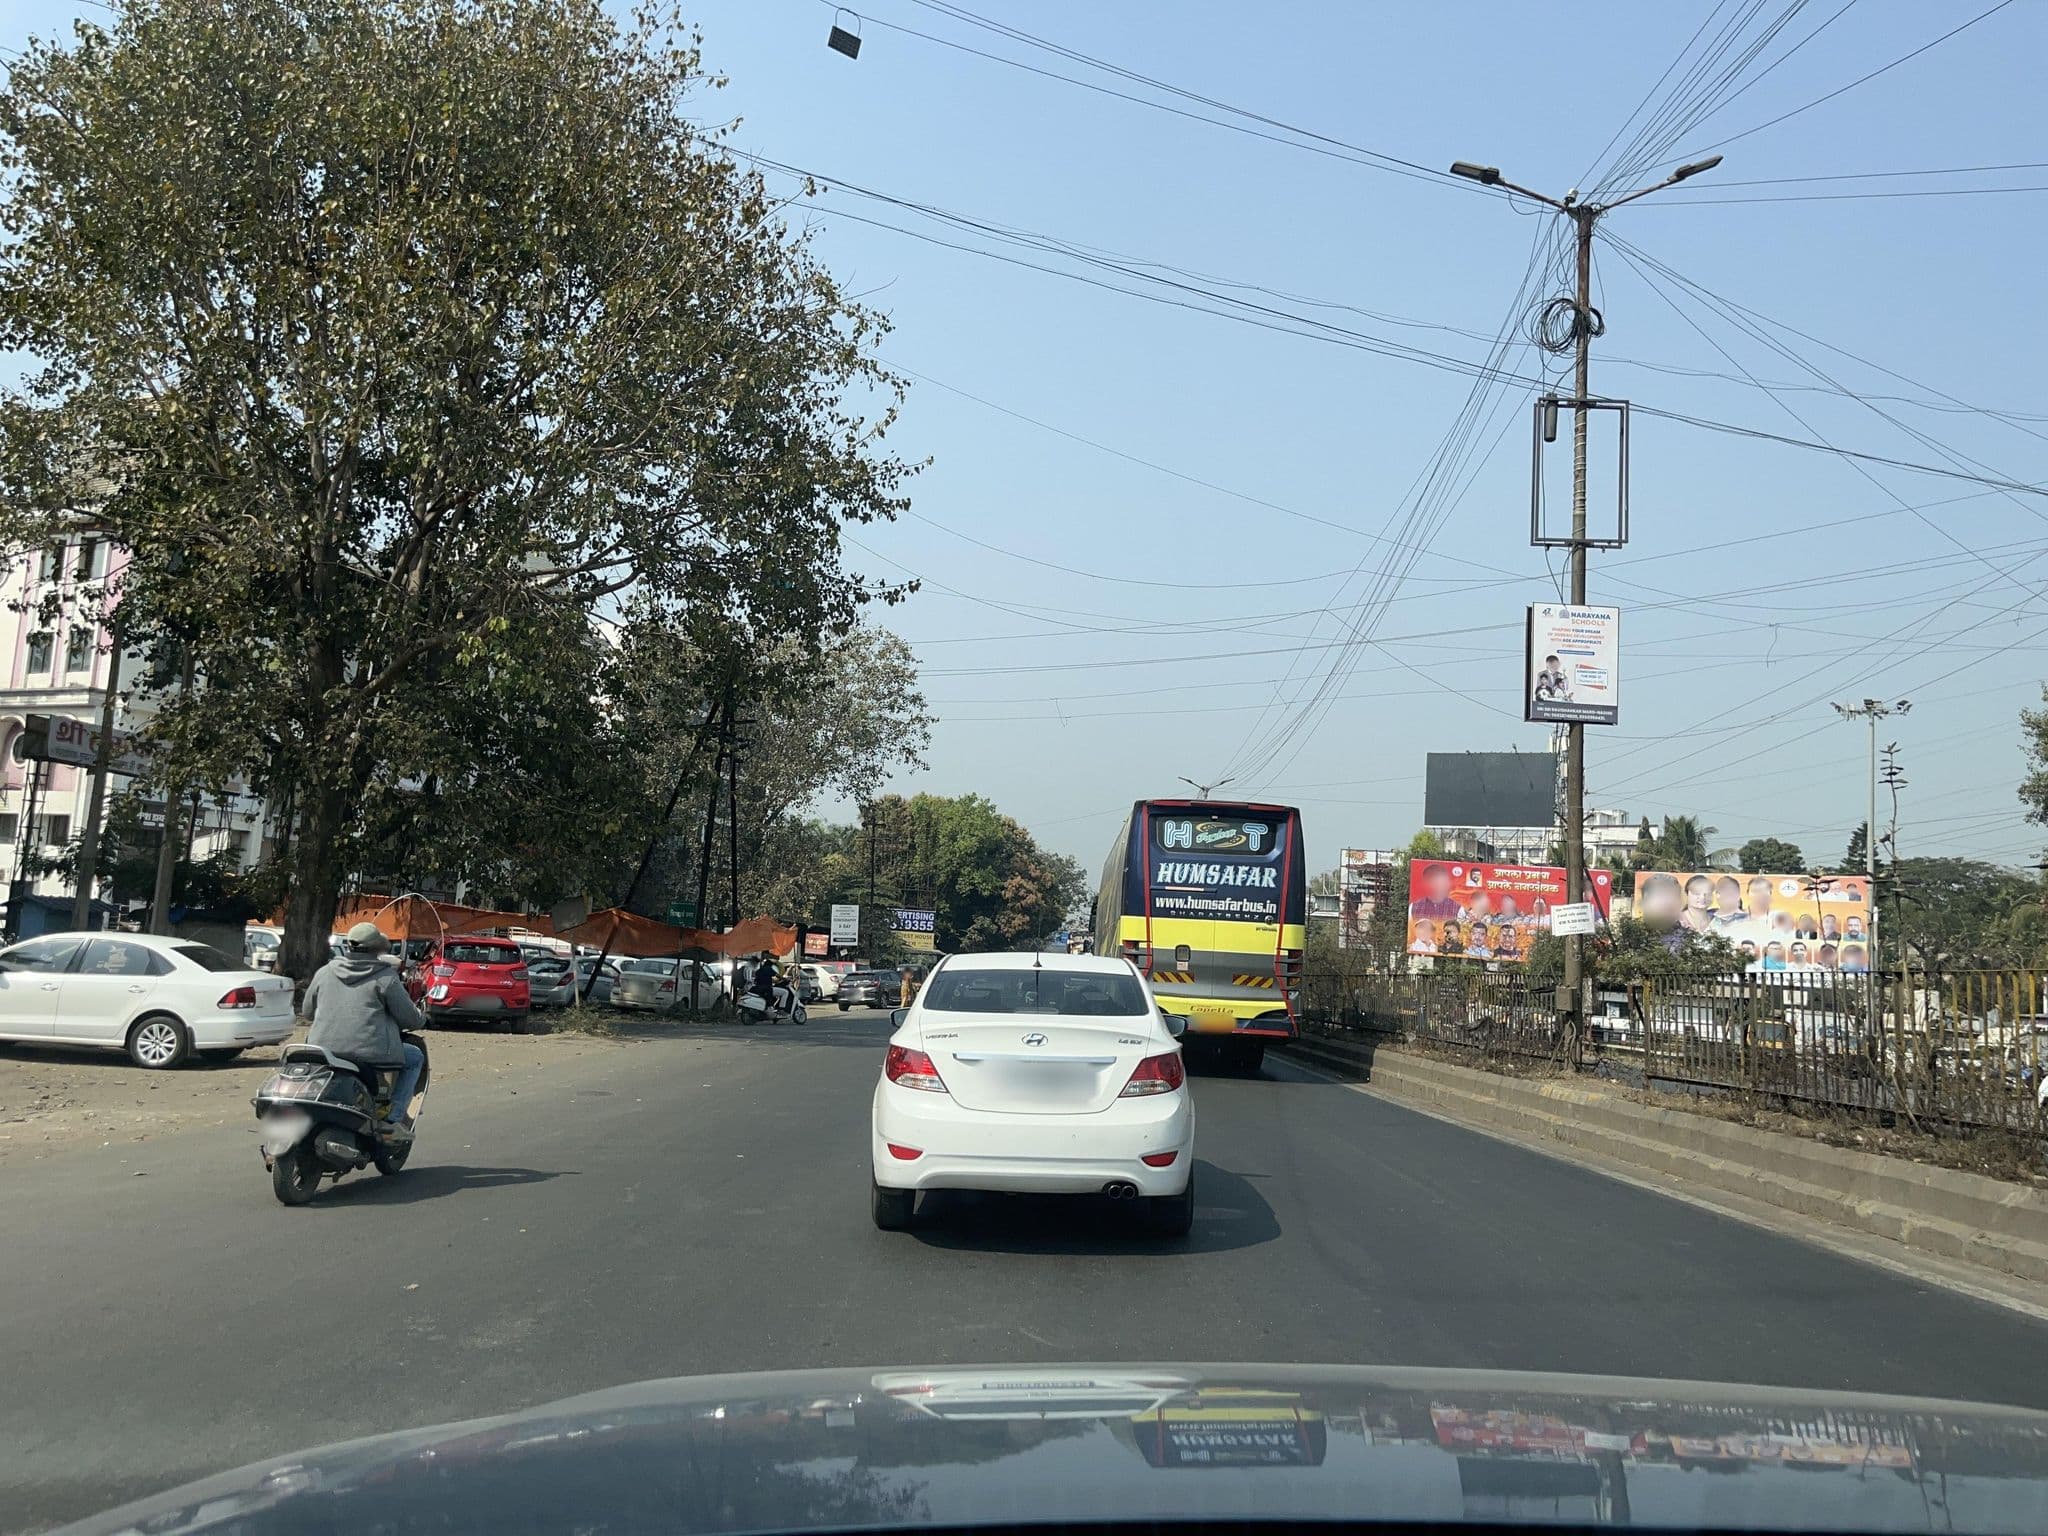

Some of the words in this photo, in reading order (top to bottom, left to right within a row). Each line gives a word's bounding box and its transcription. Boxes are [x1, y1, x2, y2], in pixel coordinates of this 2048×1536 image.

[1570, 611, 1611, 620] NARAYANA
[56, 720, 88, 745] श्री
[1164, 820, 1192, 848] H
[1242, 822, 1269, 852] T
[1157, 862, 1278, 888] HUMSAFAR
[1155, 895, 1278, 914] www.humsafarbus.in
